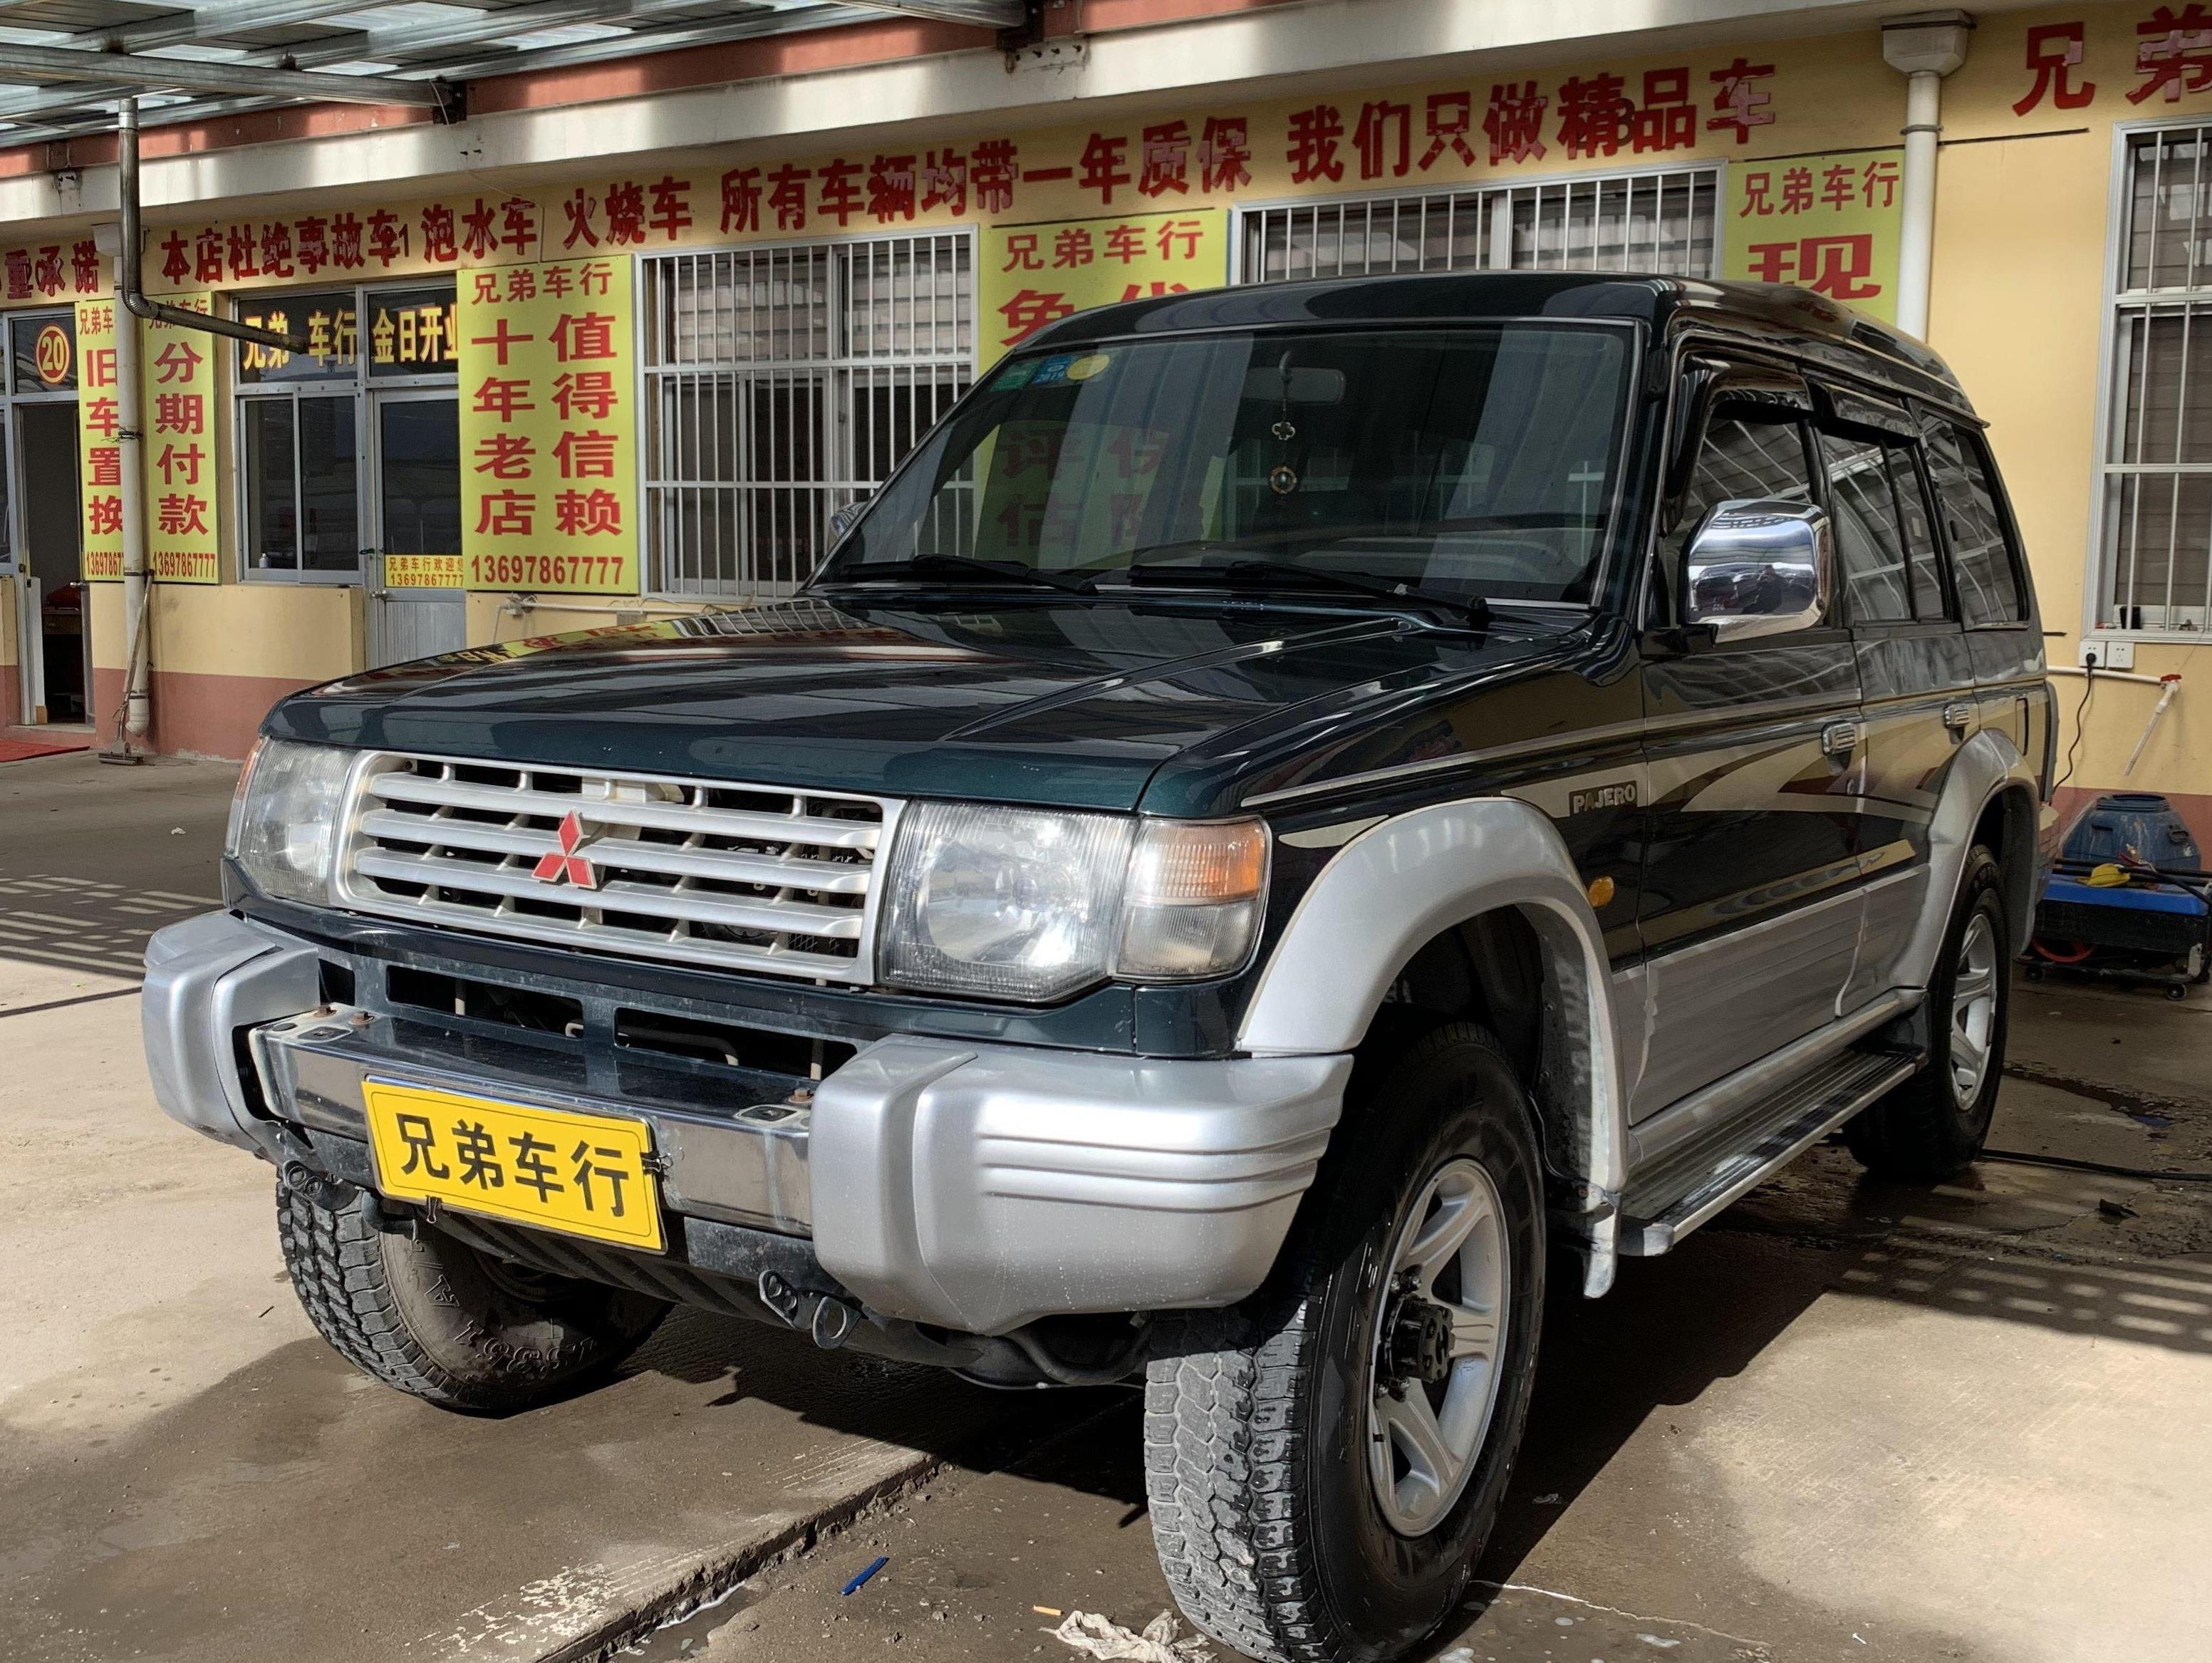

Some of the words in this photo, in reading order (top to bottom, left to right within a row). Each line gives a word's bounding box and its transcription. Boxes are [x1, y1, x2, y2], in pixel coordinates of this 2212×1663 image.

[161, 208, 400, 285] 本店杜绝事故车
[563, 175, 693, 250] 火烧车
[719, 115, 1252, 234] 所有车辆均带一年质保
[1286, 57, 1776, 185] 我们只做精品车
[1739, 161, 1900, 218] 兄弟车行
[1002, 221, 1204, 273] 兄弟车行
[471, 262, 613, 306] 兄弟车行
[41, 336, 65, 371] 20
[308, 307, 355, 368] 车行
[86, 348, 123, 536] 旧车置换
[154, 341, 209, 536] 分期付款
[471, 318, 536, 537] 十年老店
[548, 311, 623, 537] 值得信赖
[86, 551, 123, 576] 13697867
[152, 551, 216, 579] 13697867777
[390, 573, 464, 586] 13697867777
[471, 554, 624, 586] 13697867777
[1573, 784, 1636, 814] PAJERO
[395, 1112, 630, 1217] 兄弟车行
